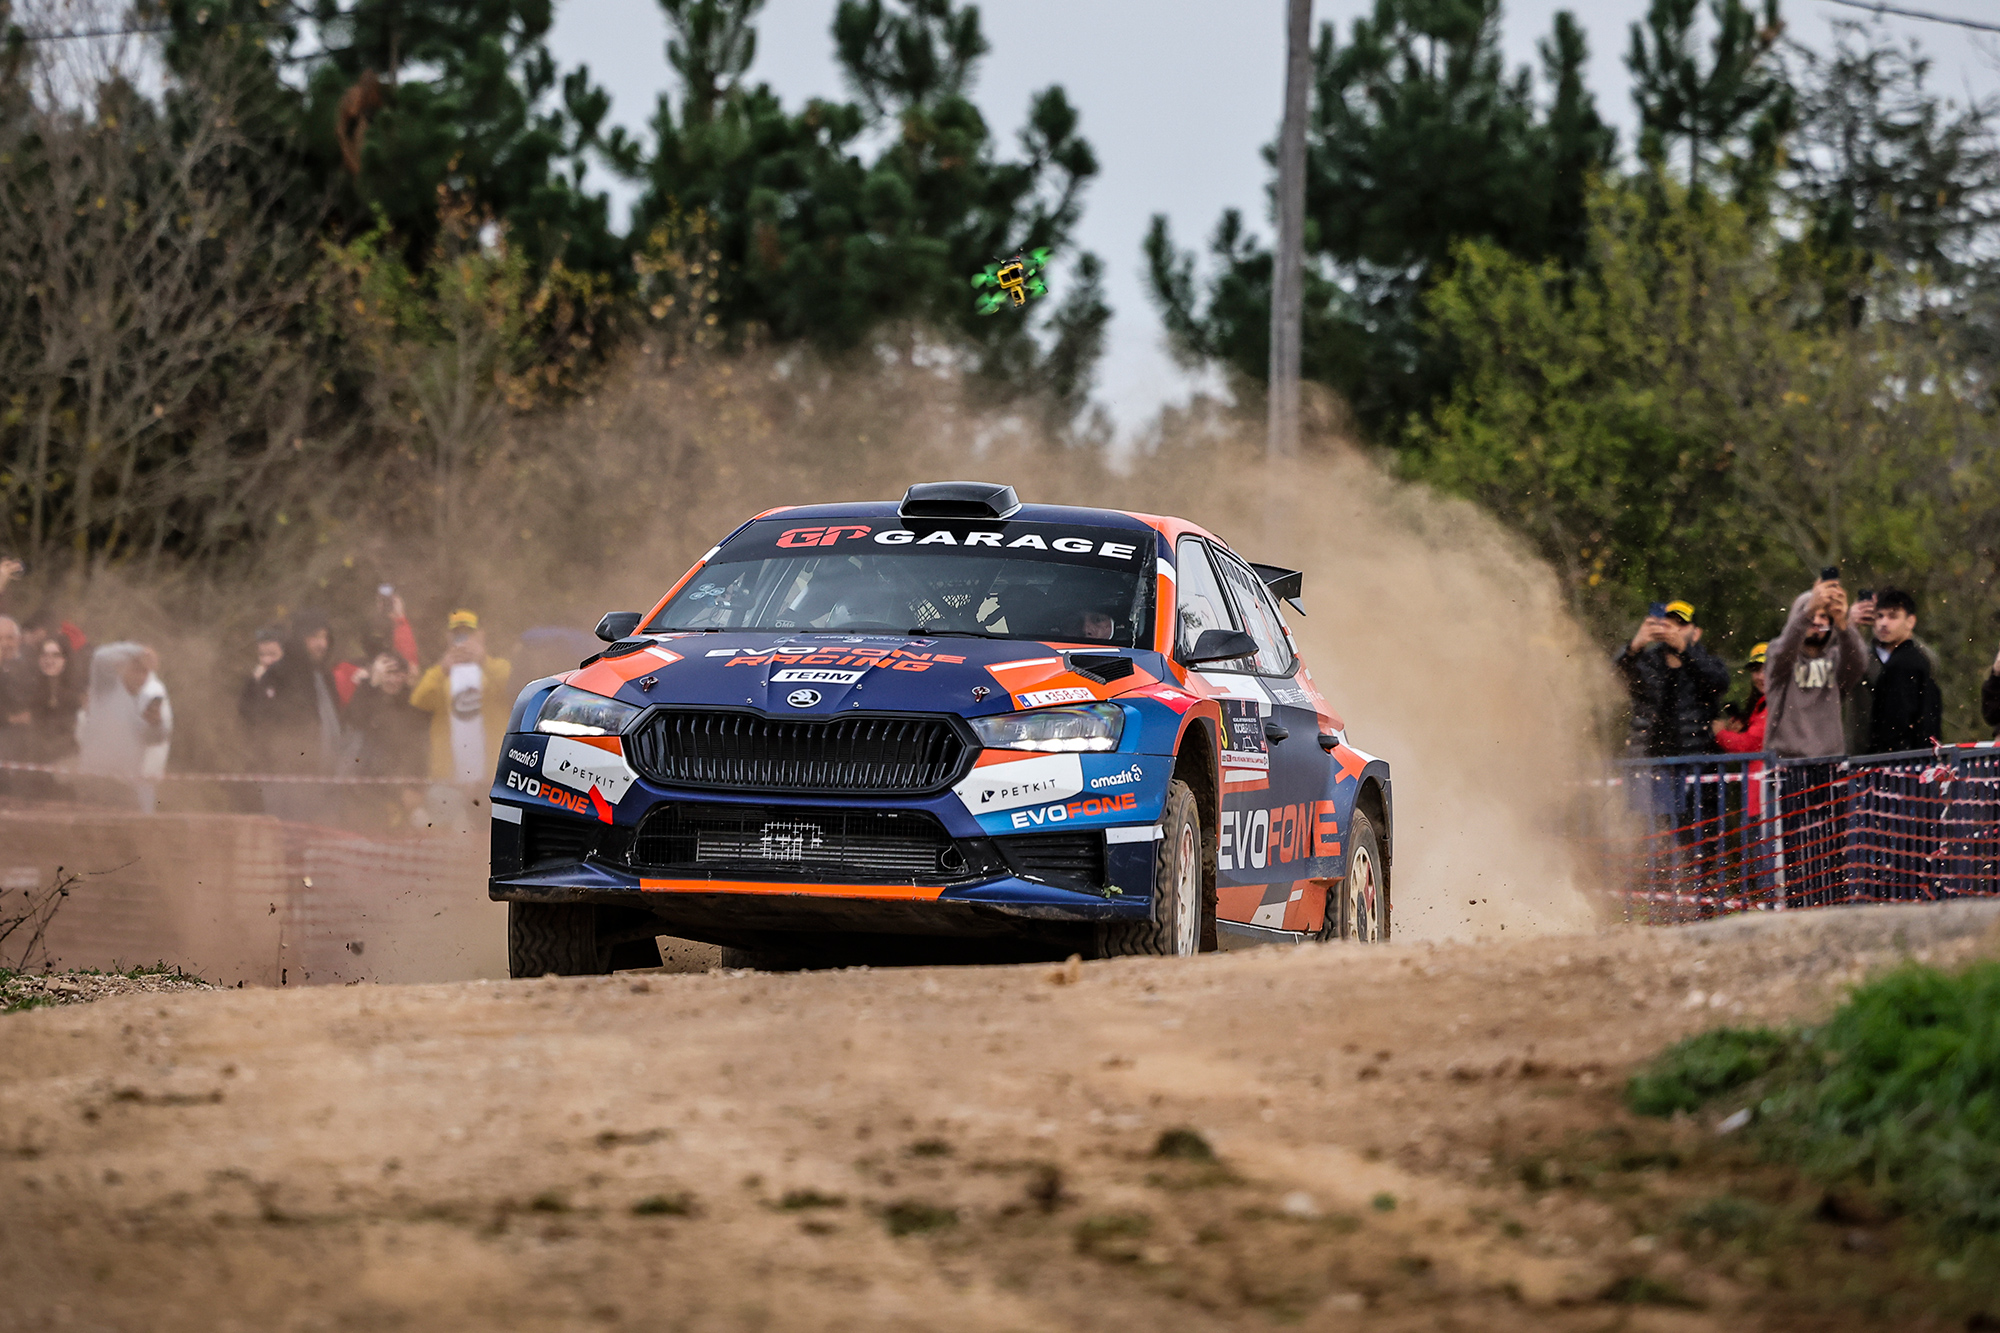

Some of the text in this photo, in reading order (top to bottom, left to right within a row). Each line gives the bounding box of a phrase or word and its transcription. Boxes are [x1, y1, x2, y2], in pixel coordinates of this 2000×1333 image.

[775, 525, 1137, 561] GP GARAGE
[704, 646, 967, 664] EVOFONE
[724, 653, 935, 673] RACING
[784, 671, 853, 682] TEAM
[572, 767, 615, 789] PETKIT
[1001, 779, 1056, 798] PETKIT
[1090, 769, 1135, 788] amazfit
[506, 770, 590, 815] EVOFONE
[1010, 793, 1137, 829] EVOFONE
[1218, 800, 1341, 870] EVOFONE
